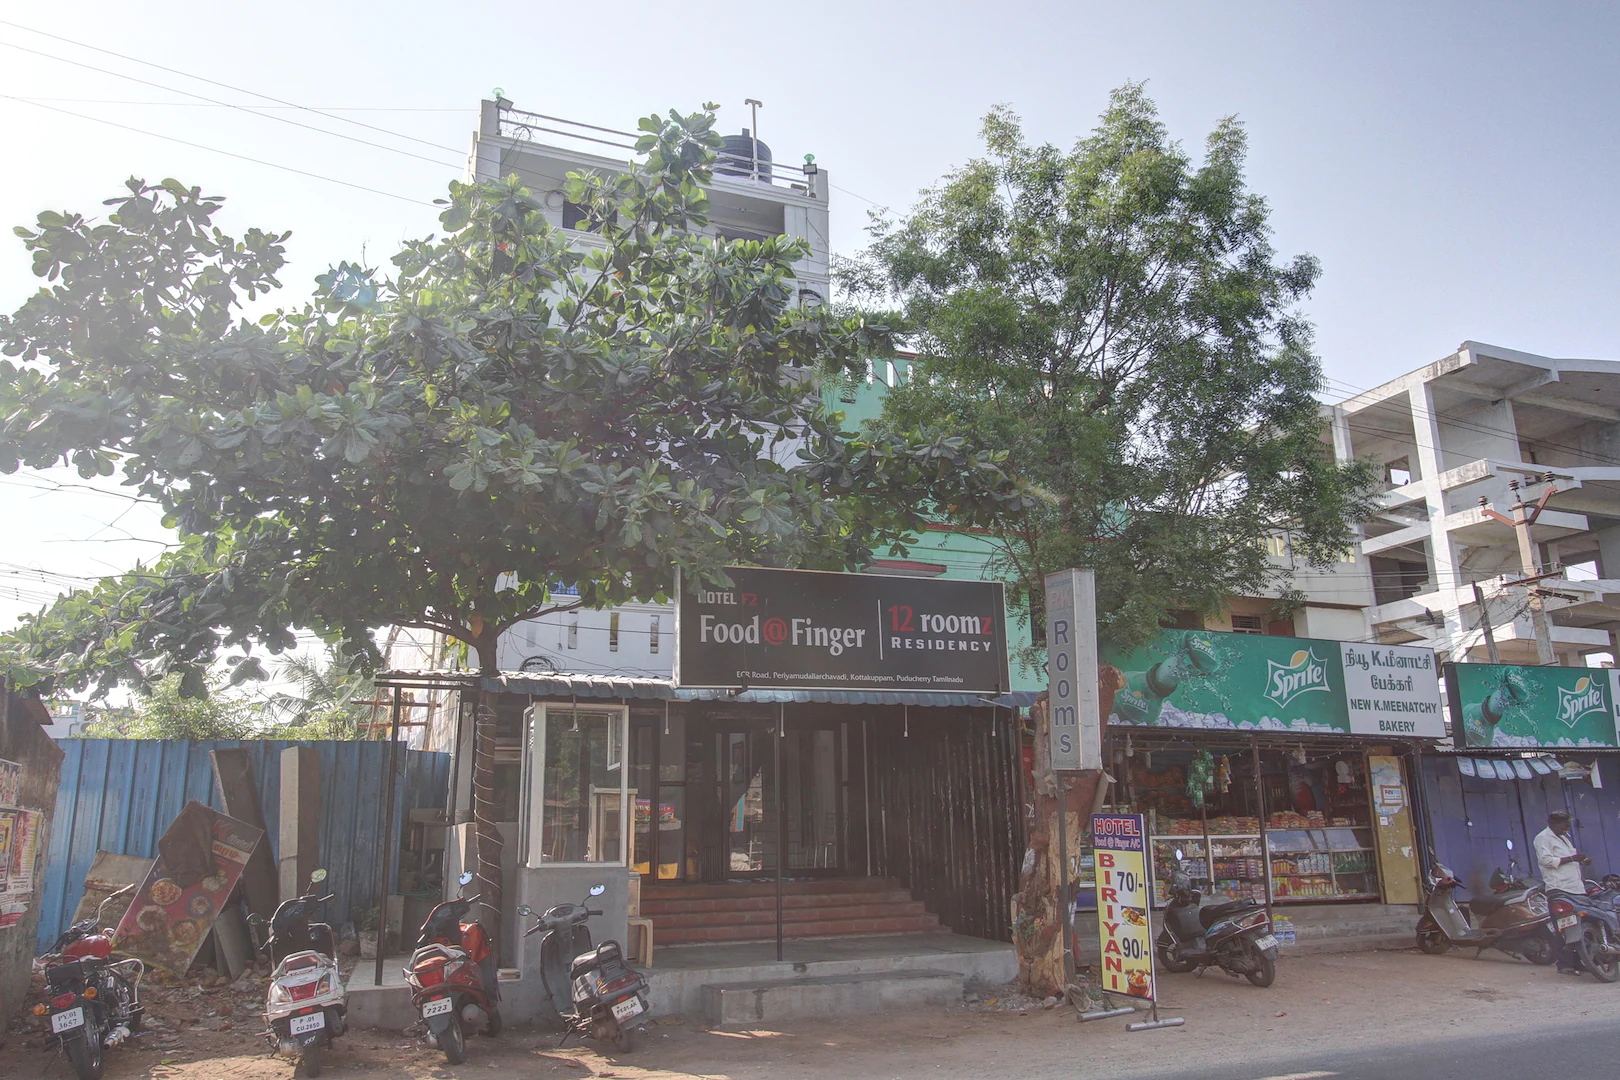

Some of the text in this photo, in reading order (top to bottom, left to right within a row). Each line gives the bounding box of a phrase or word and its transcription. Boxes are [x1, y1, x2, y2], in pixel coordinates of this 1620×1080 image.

[742, 593, 758, 606] F2
[888, 604, 993, 635] 12 roomz
[700, 615, 866, 656] Food @ Finger
[891, 636, 992, 652] RESIDENCY
[896, 674, 931, 684] Puducherry
[1053, 619, 1076, 754] Rooms
[1271, 663, 1323, 701] Sprite
[1370, 673, 1414, 692] பேக்கரி
[1350, 699, 1437, 714] NEW K.MEENATCHY
[1561, 687, 1600, 721] Sprite
[1379, 720, 1415, 732] BAKERY
[1094, 817, 1140, 836] HOTEL
[1117, 871, 1143, 893] 70/-
[1098, 852, 1123, 991] BIRIYANI
[1122, 937, 1149, 960] 90/-
[427, 1004, 448, 1014] 7223
